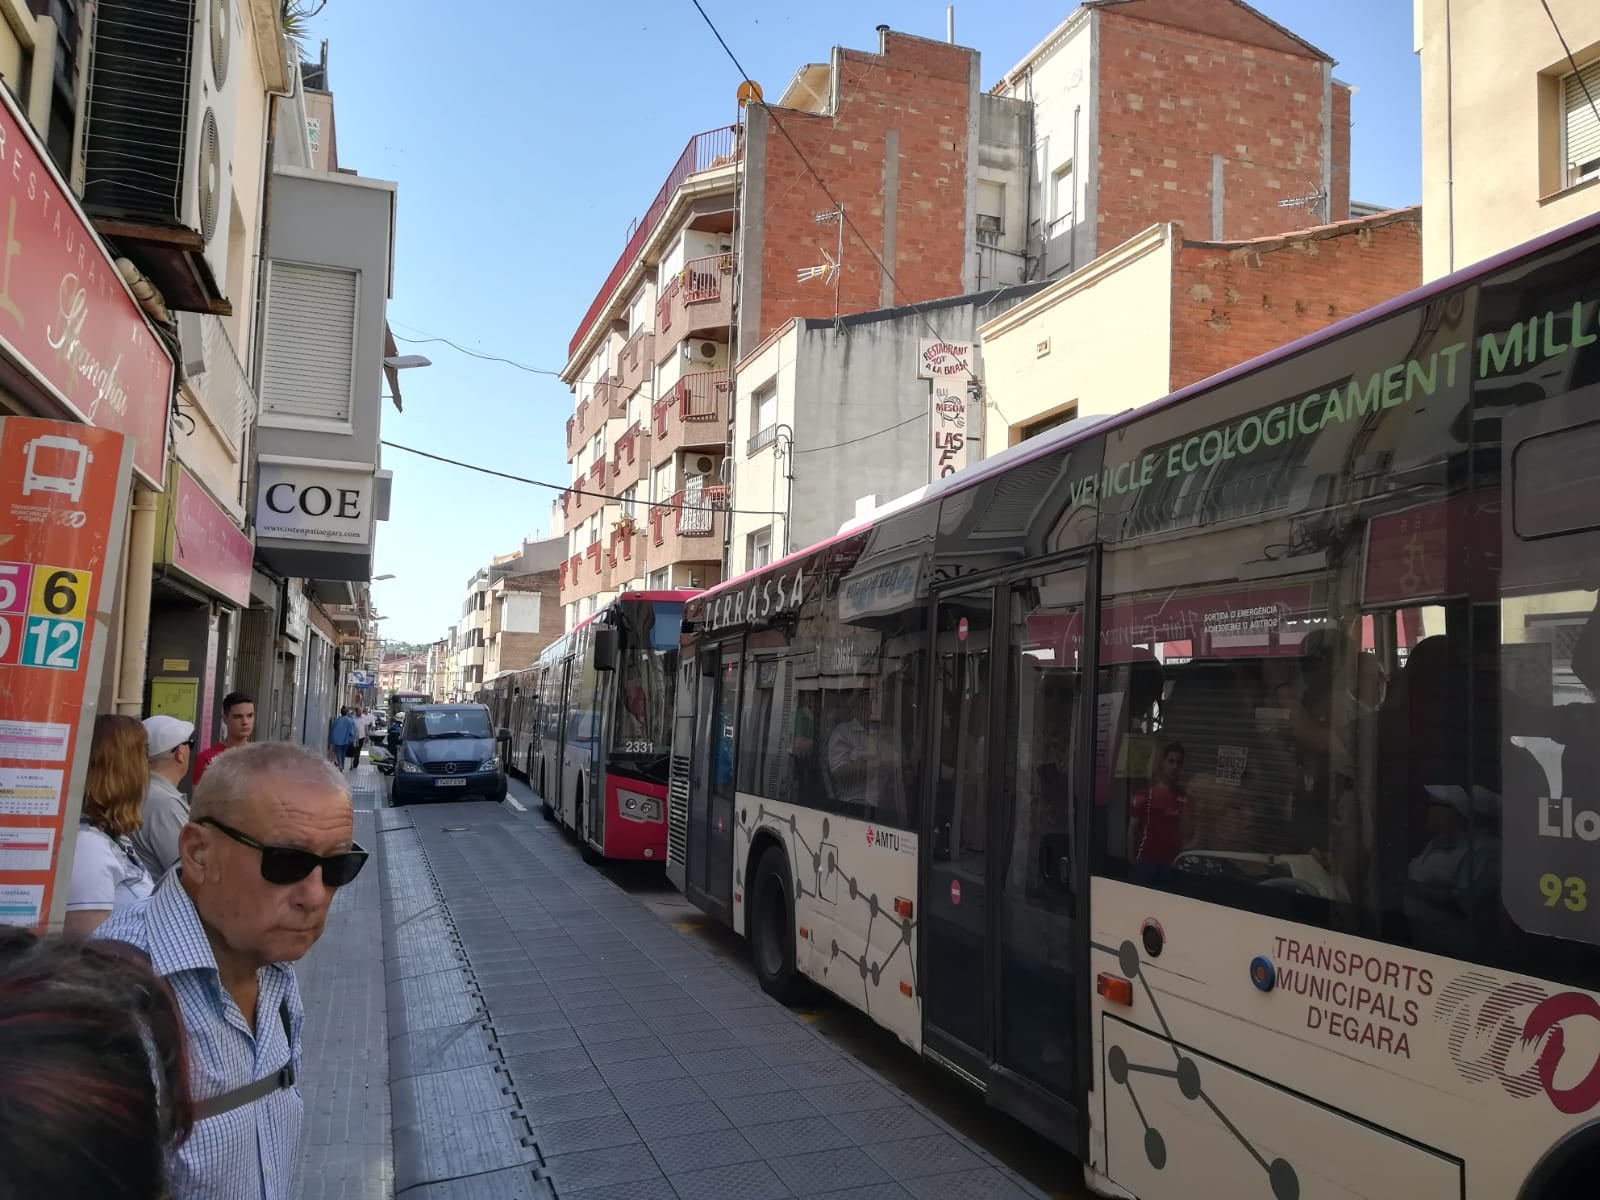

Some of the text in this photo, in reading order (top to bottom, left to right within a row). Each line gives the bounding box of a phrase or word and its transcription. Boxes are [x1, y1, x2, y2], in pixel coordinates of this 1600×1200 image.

[923, 342, 968, 361] RESTAURANT
[1069, 301, 1600, 505] VEHICLE ECOLOGICAMENT MILL
[936, 431, 964, 451] LAS
[265, 482, 361, 519] COE
[43, 570, 79, 615] 6
[702, 567, 804, 633] TERRASSA
[29, 620, 79, 667] 12
[625, 740, 654, 754] 2331
[875, 830, 900, 851] AMTU
[1538, 796, 1600, 841] Llo
[1539, 872, 1588, 912] 93
[1275, 935, 1434, 996] TRANSPORTS
[1276, 966, 1419, 1027] MUNICIPALS
[1306, 1005, 1411, 1059] D'EGARA
